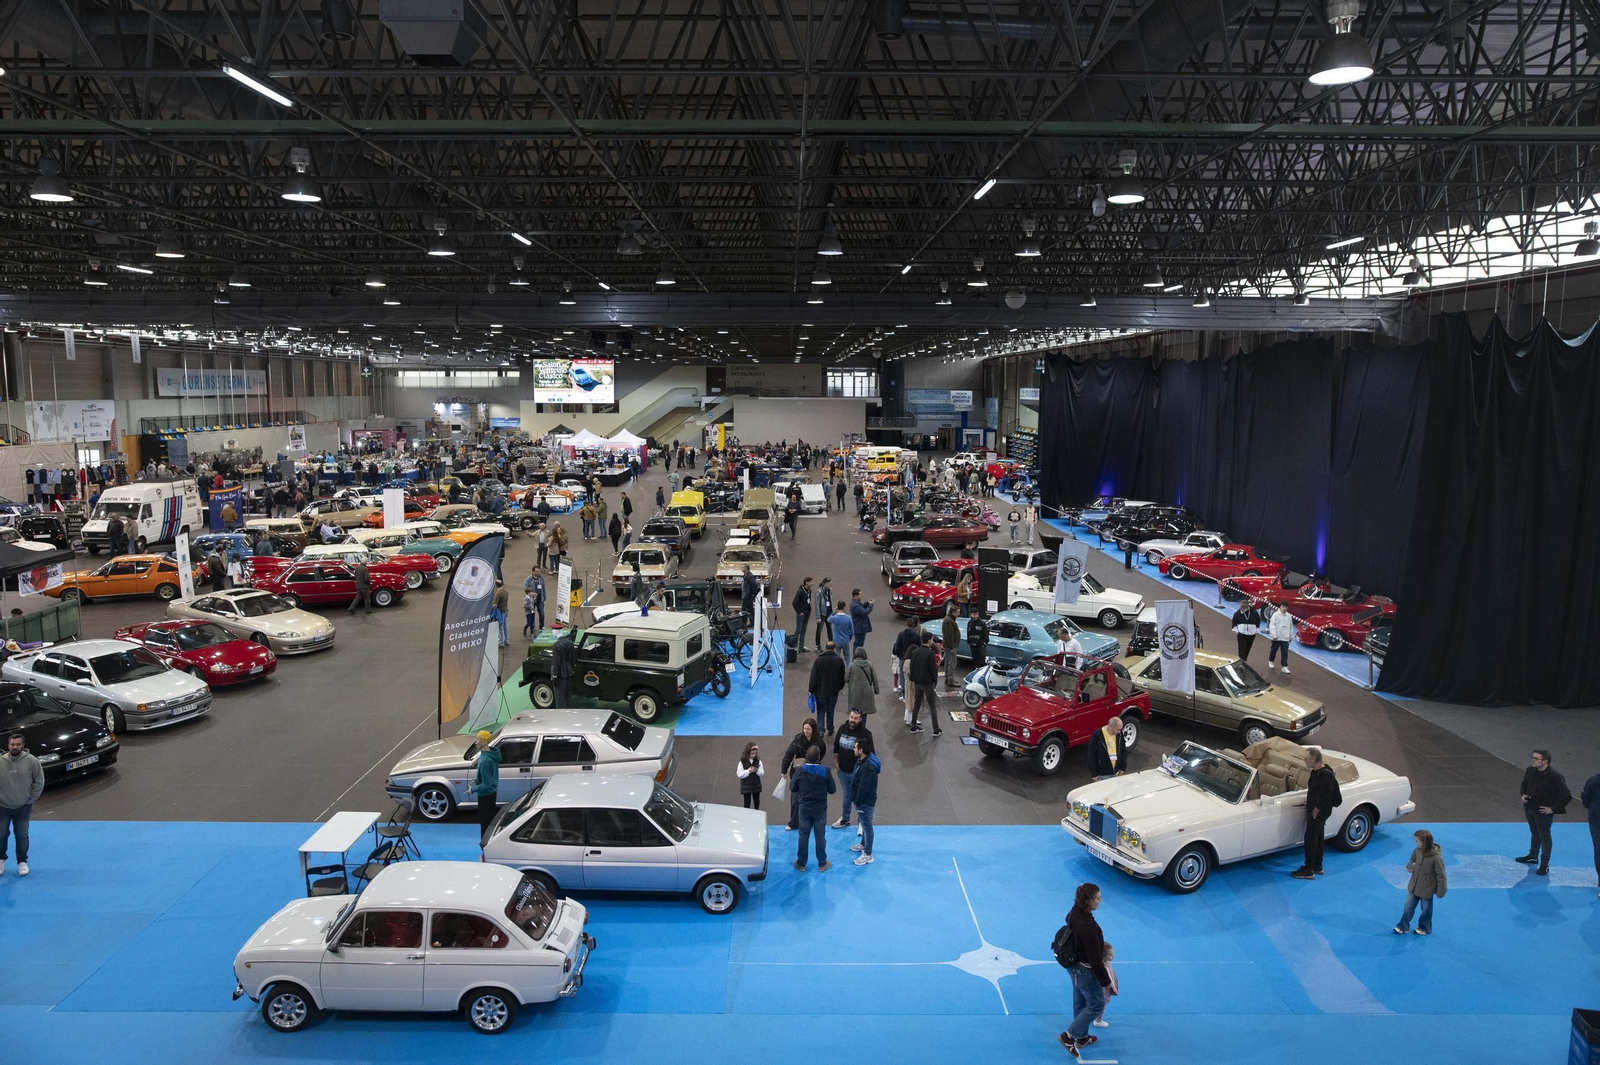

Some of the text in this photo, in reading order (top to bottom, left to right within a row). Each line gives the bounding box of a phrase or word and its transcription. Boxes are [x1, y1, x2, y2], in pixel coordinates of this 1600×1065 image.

[182, 374, 220, 390] OURENSE
[445, 614, 490, 630] Asociación
[449, 627, 485, 641] Clásicos
[450, 638, 482, 652] O IRIXO
